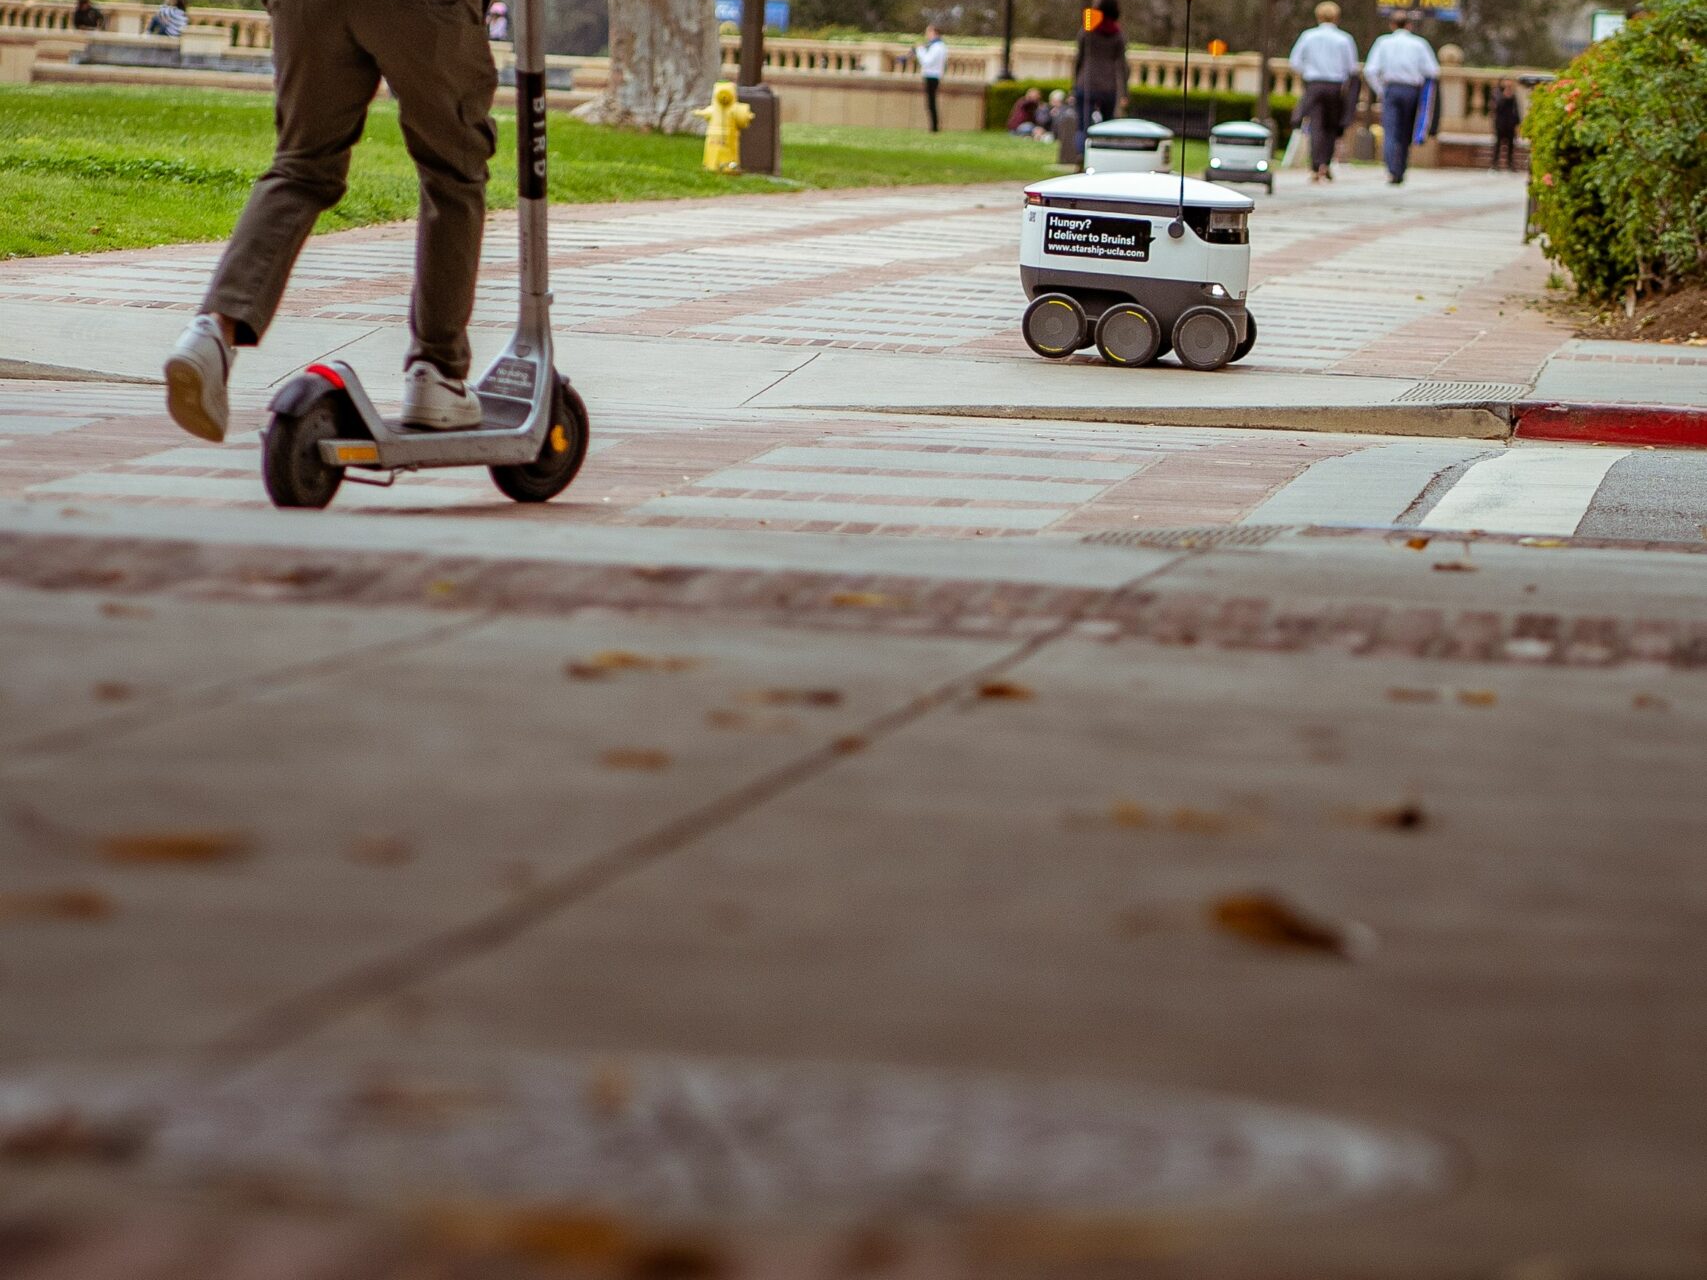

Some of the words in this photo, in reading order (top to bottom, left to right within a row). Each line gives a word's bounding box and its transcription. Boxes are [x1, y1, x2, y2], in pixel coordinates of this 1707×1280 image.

[533, 96, 546, 178] BIRD
[1050, 216, 1092, 230] Hungry?
[1049, 229, 1053, 239] I
[1053, 230, 1089, 241] deliver
[1089, 233, 1100, 243] to
[1101, 233, 1135, 246] Bruins!
[1048, 243, 1145, 258] www.starship-ucla.com
